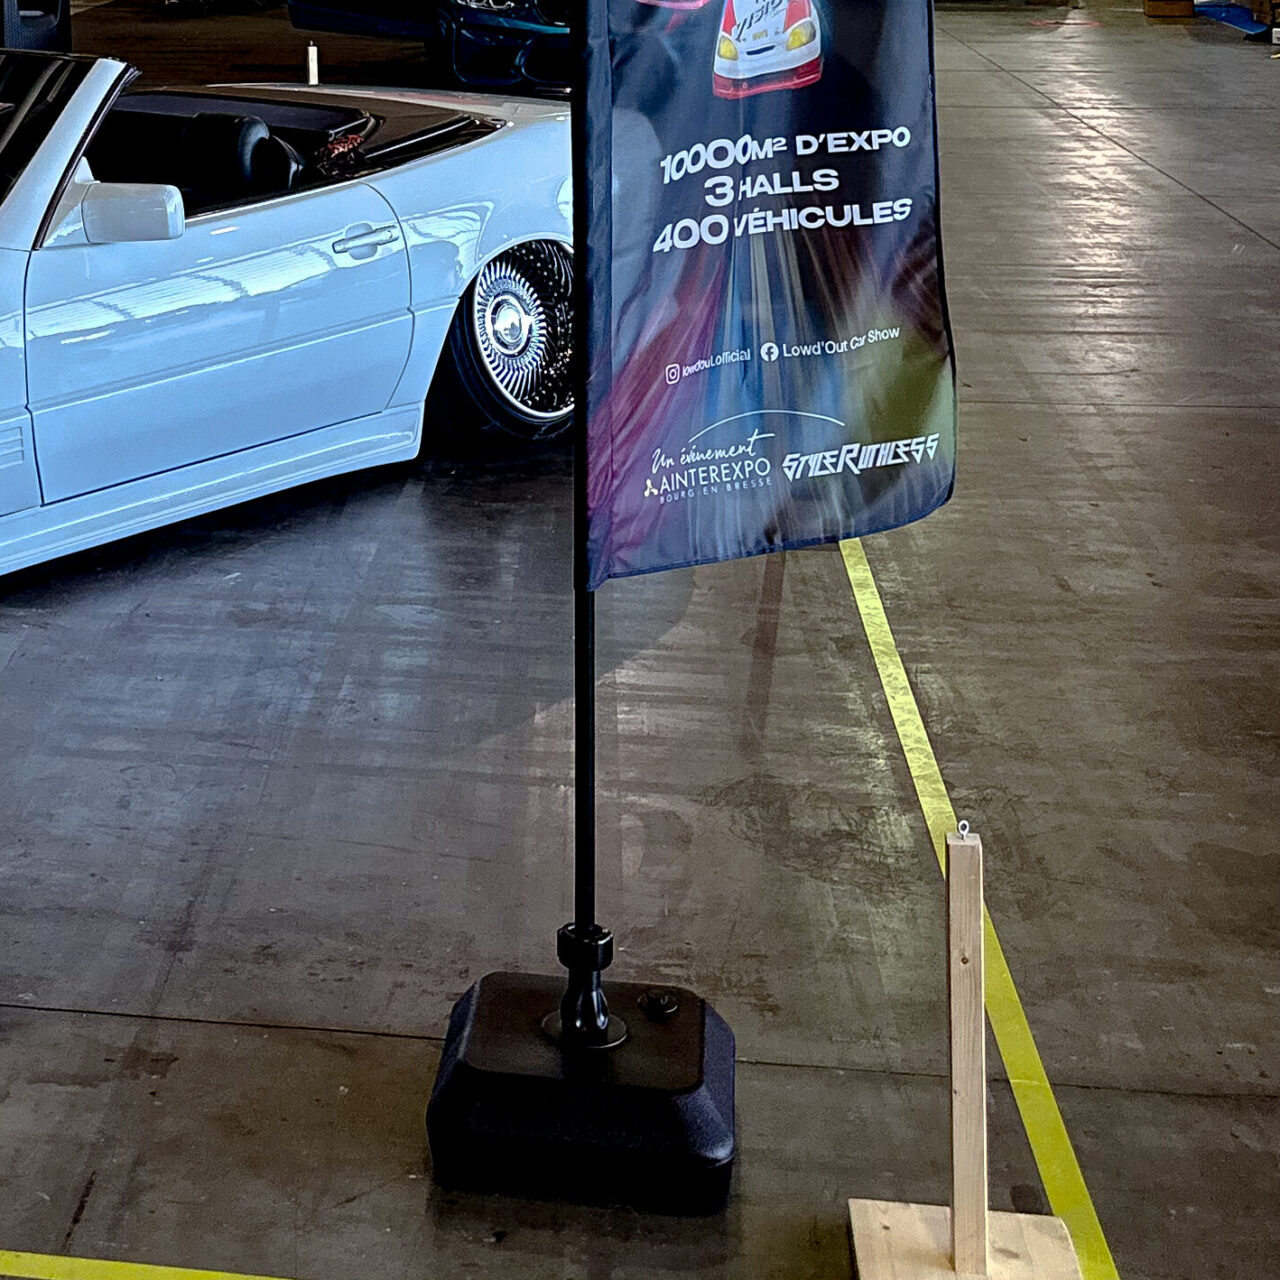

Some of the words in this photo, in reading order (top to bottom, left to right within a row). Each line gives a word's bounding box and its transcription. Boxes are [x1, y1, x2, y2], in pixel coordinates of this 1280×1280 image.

[795, 126, 911, 156] D'EXPO
[704, 175, 734, 207] 3
[738, 169, 840, 201] HALLS
[653, 214, 729, 253] 400
[734, 198, 913, 237] VÉHICULES
[782, 339, 848, 358] Lowd'Out
[867, 326, 900, 345] Show
[659, 489, 695, 504] BOURG
[702, 484, 719, 495] EN
[726, 476, 773, 492] BRESSE
[660, 457, 771, 495] AINTEREXPO
